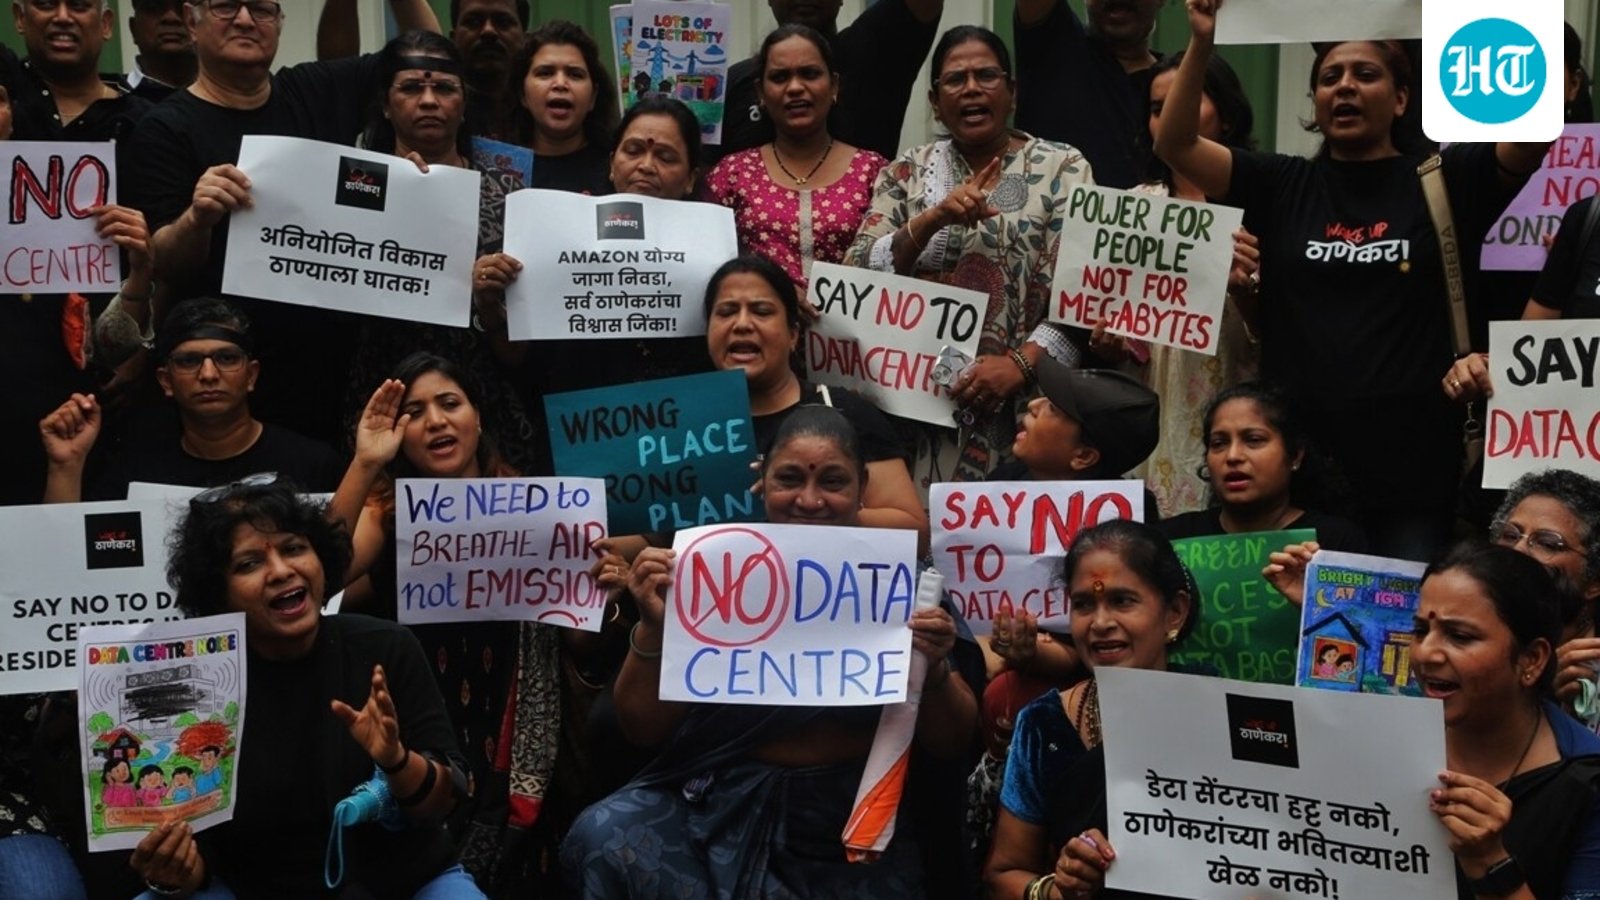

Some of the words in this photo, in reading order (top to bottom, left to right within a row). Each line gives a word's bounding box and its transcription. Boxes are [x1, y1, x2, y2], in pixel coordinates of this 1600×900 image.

[641, 27, 724, 44] ELECTRICITY
[654, 14, 690, 28] LOTS
[693, 17, 712, 30] OF
[8, 155, 110, 224] NO
[1069, 187, 1151, 231] POWER
[1160, 203, 1214, 242] FOR
[1368, 221, 1388, 239] UP
[4, 243, 115, 286] CENTRE
[260, 224, 375, 260] अनियोजित
[379, 240, 447, 271] विकास
[557, 250, 639, 264] AMAZON
[644, 247, 686, 264] योग्य
[1093, 228, 1194, 273] PEOPLE
[1441, 224, 1462, 302] ESBEDA
[269, 256, 359, 285] ठाण्याला
[363, 269, 430, 296] घातक!
[572, 271, 614, 287] जागा
[618, 267, 672, 287] निवडा,
[1082, 264, 1133, 297] NOT
[1142, 273, 1188, 307] FOR
[564, 290, 594, 310] सर्व
[595, 291, 682, 310] ठाणेकरांचा
[812, 276, 875, 321] SAY
[875, 287, 925, 330] NO
[930, 296, 978, 342] TO
[1058, 289, 1213, 350] MEGABYTES
[568, 314, 622, 334] विश्वास
[627, 313, 677, 333] जिंका!
[1506, 334, 1600, 387] SAY
[560, 397, 680, 445] WRONG
[637, 418, 748, 467] PLACE
[404, 483, 456, 524] We
[465, 482, 549, 521] NEED
[557, 481, 590, 509] to
[941, 491, 1027, 531] SAY
[411, 529, 538, 567] BREATHE
[548, 521, 605, 561] AIR
[946, 543, 1004, 583] TO
[13, 598, 62, 618] SAY
[71, 595, 109, 615] NO
[116, 593, 148, 612] TO
[401, 571, 459, 611] not
[690, 551, 777, 625] NO
[794, 559, 913, 624] DATA
[1335, 587, 1356, 600] AT
[89, 646, 130, 665] DATA
[133, 639, 194, 662] CENTRE
[196, 634, 236, 656] NOISE
[685, 647, 904, 698] CENTRE
[1145, 768, 1187, 801] डेटा
[1193, 775, 1279, 814] सेंटरचा
[1285, 793, 1321, 828] हट्ट
[1327, 801, 1401, 838] नको,
[1123, 808, 1269, 851] ठाणेकरांच्या
[1277, 827, 1430, 875] भवितव्याशी
[1206, 855, 1261, 888] खेळ
[1267, 867, 1340, 900] नको!
